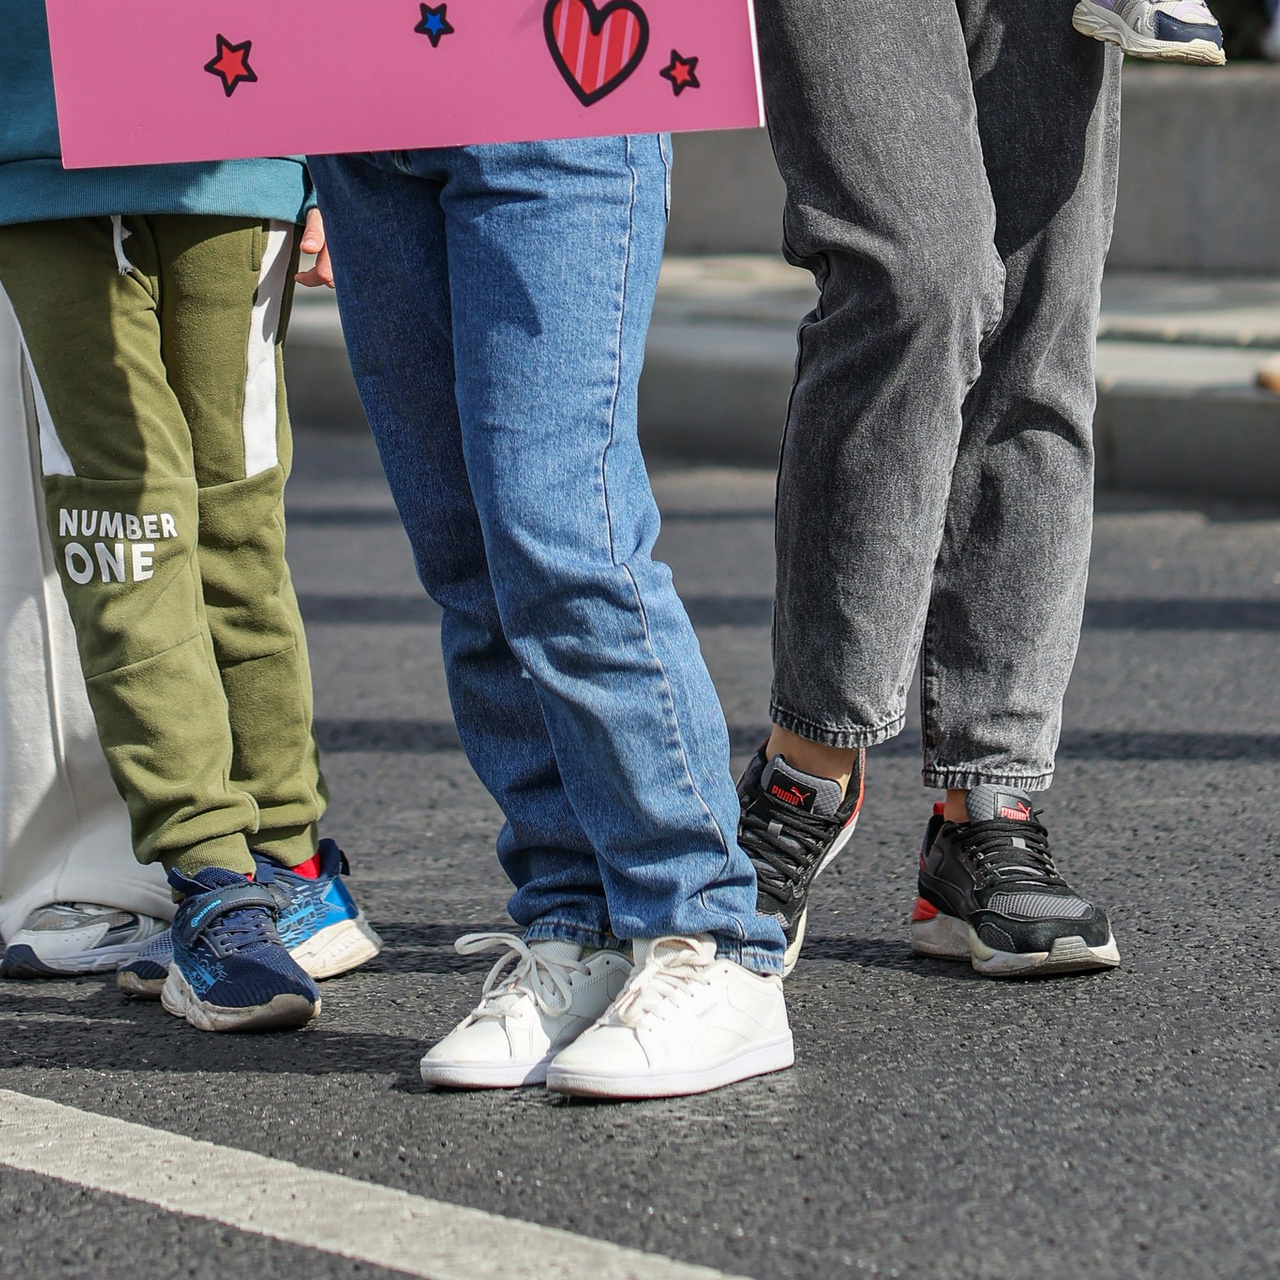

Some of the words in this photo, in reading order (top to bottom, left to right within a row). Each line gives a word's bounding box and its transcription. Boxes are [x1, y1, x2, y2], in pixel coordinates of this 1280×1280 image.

[59, 508, 180, 540] NUMBER
[64, 542, 156, 585] ONE
[771, 785, 800, 806] PUMA
[1001, 806, 1028, 822] PUMA
